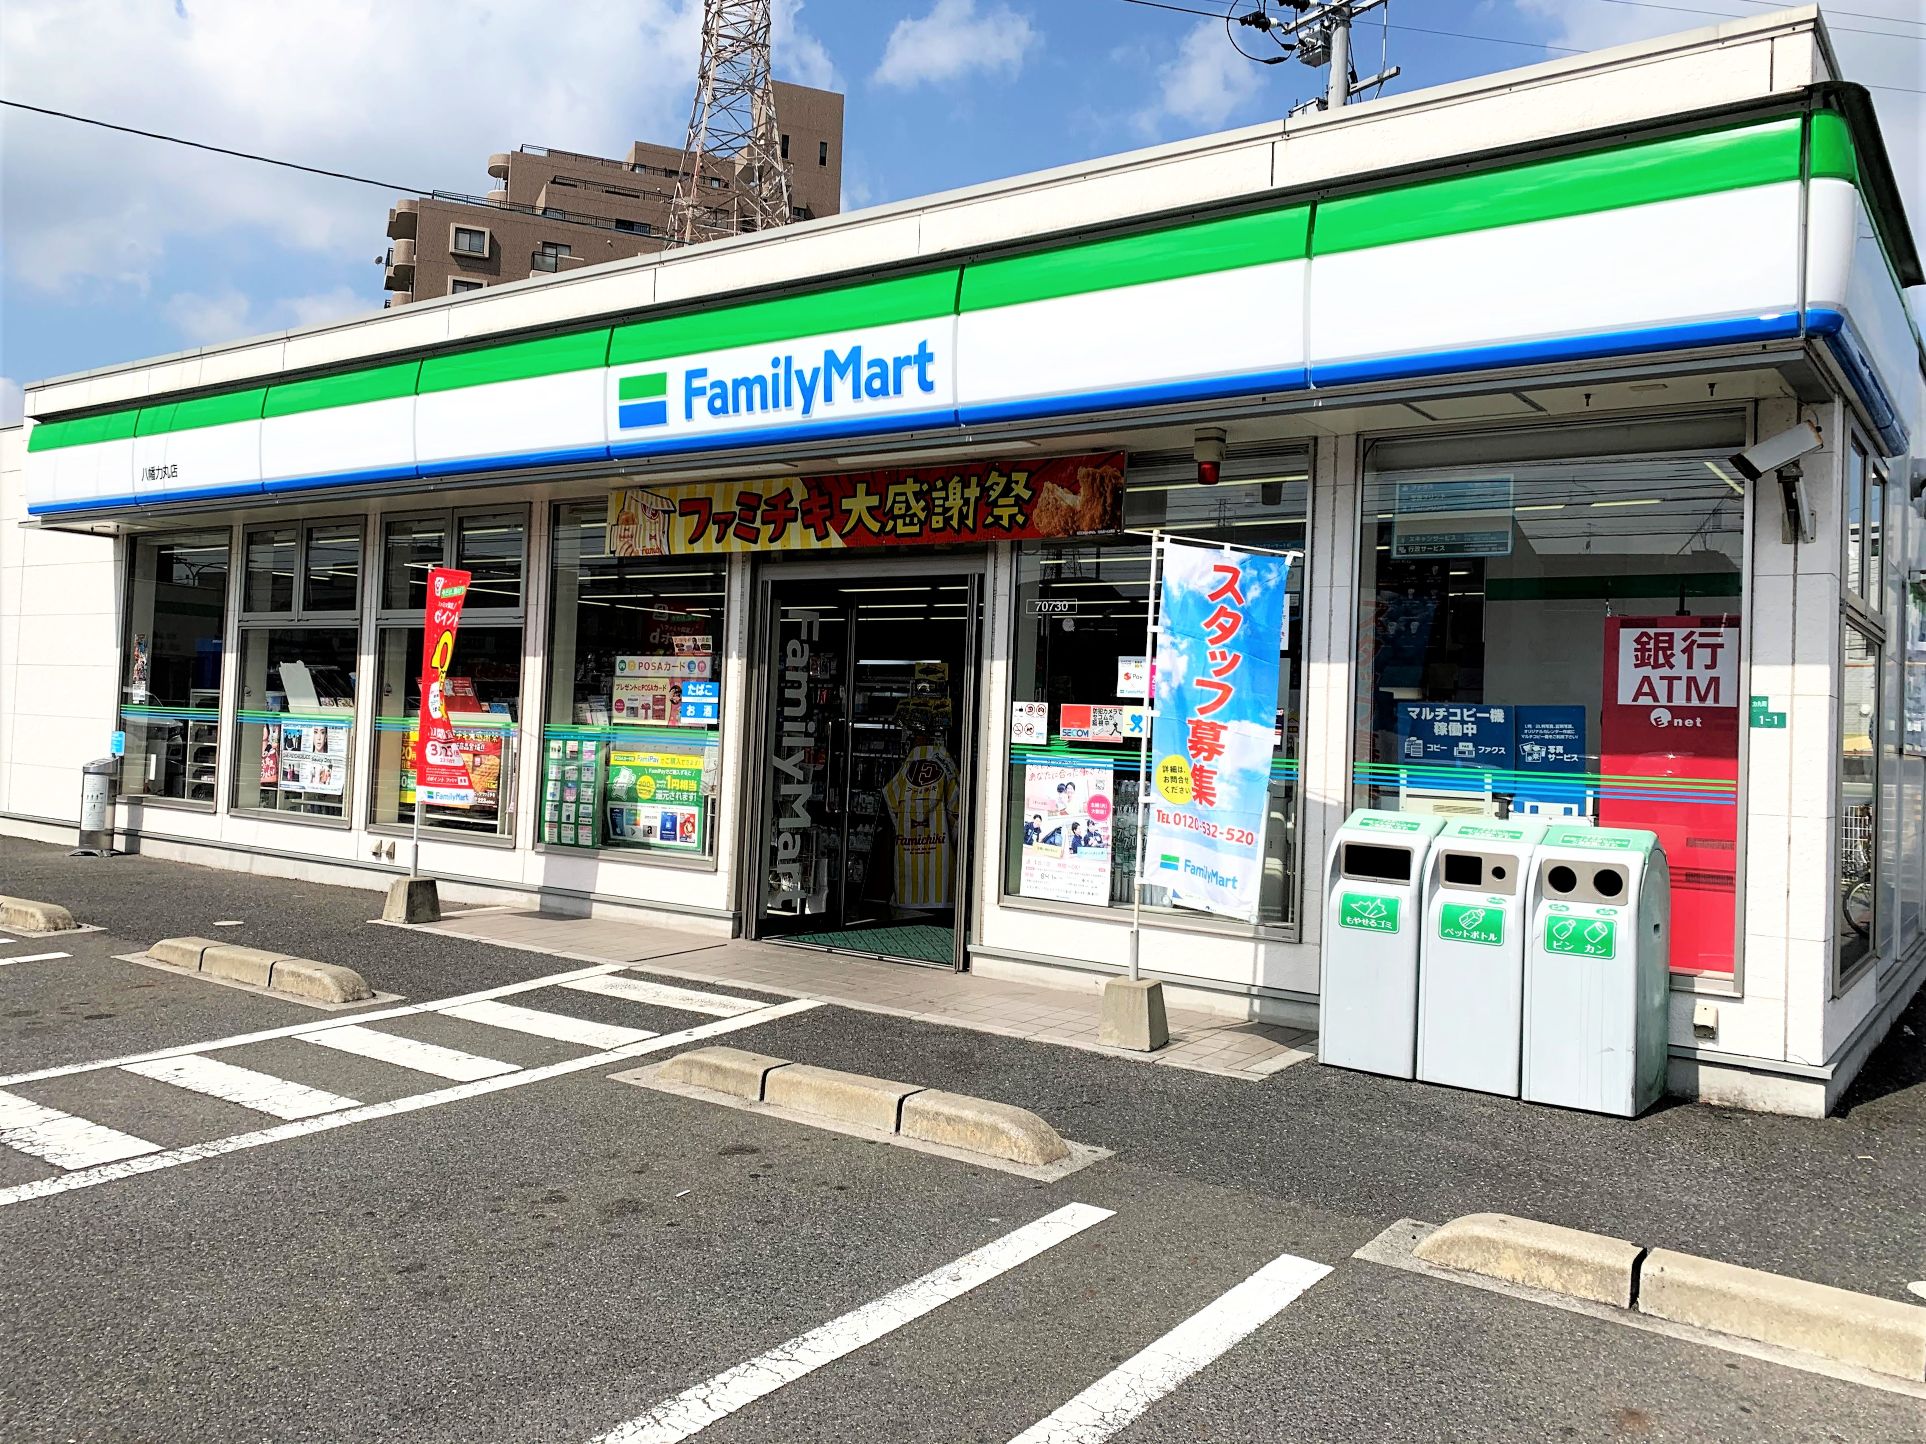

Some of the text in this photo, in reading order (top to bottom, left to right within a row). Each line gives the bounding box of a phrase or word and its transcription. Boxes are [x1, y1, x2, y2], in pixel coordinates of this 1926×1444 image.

[685, 339, 935, 421] FamilyMart
[141, 464, 178, 482] 八幡力丸店
[1035, 602, 1068, 612] 70730
[1633, 630, 1725, 671] 銀行
[638, 661, 686, 672] POSAカード
[687, 684, 713, 696] たばこ
[1187, 564, 1245, 807] スタッフ募集
[1631, 675, 1721, 704] ATM
[1407, 707, 1505, 723] マルチコピー機
[1759, 715, 1778, 725] 1-1
[1062, 729, 1089, 737] SECOM
[1433, 722, 1478, 737] 稼働中
[1426, 744, 1448, 752] コピー
[1477, 746, 1506, 755] ファクス
[1547, 745, 1564, 753] 写真
[772, 609, 820, 909] FamilyMart
[1547, 753, 1579, 762] サービス
[435, 791, 469, 801] FamilyMart
[1156, 809, 1254, 846] TEL 0120-532-520
[896, 833, 946, 847] Famichiki
[1184, 858, 1238, 890] FamilyMart
[1346, 916, 1393, 929] もやせるゴミ
[1444, 928, 1498, 942] ペットボトル
[1584, 943, 1607, 953] カン
